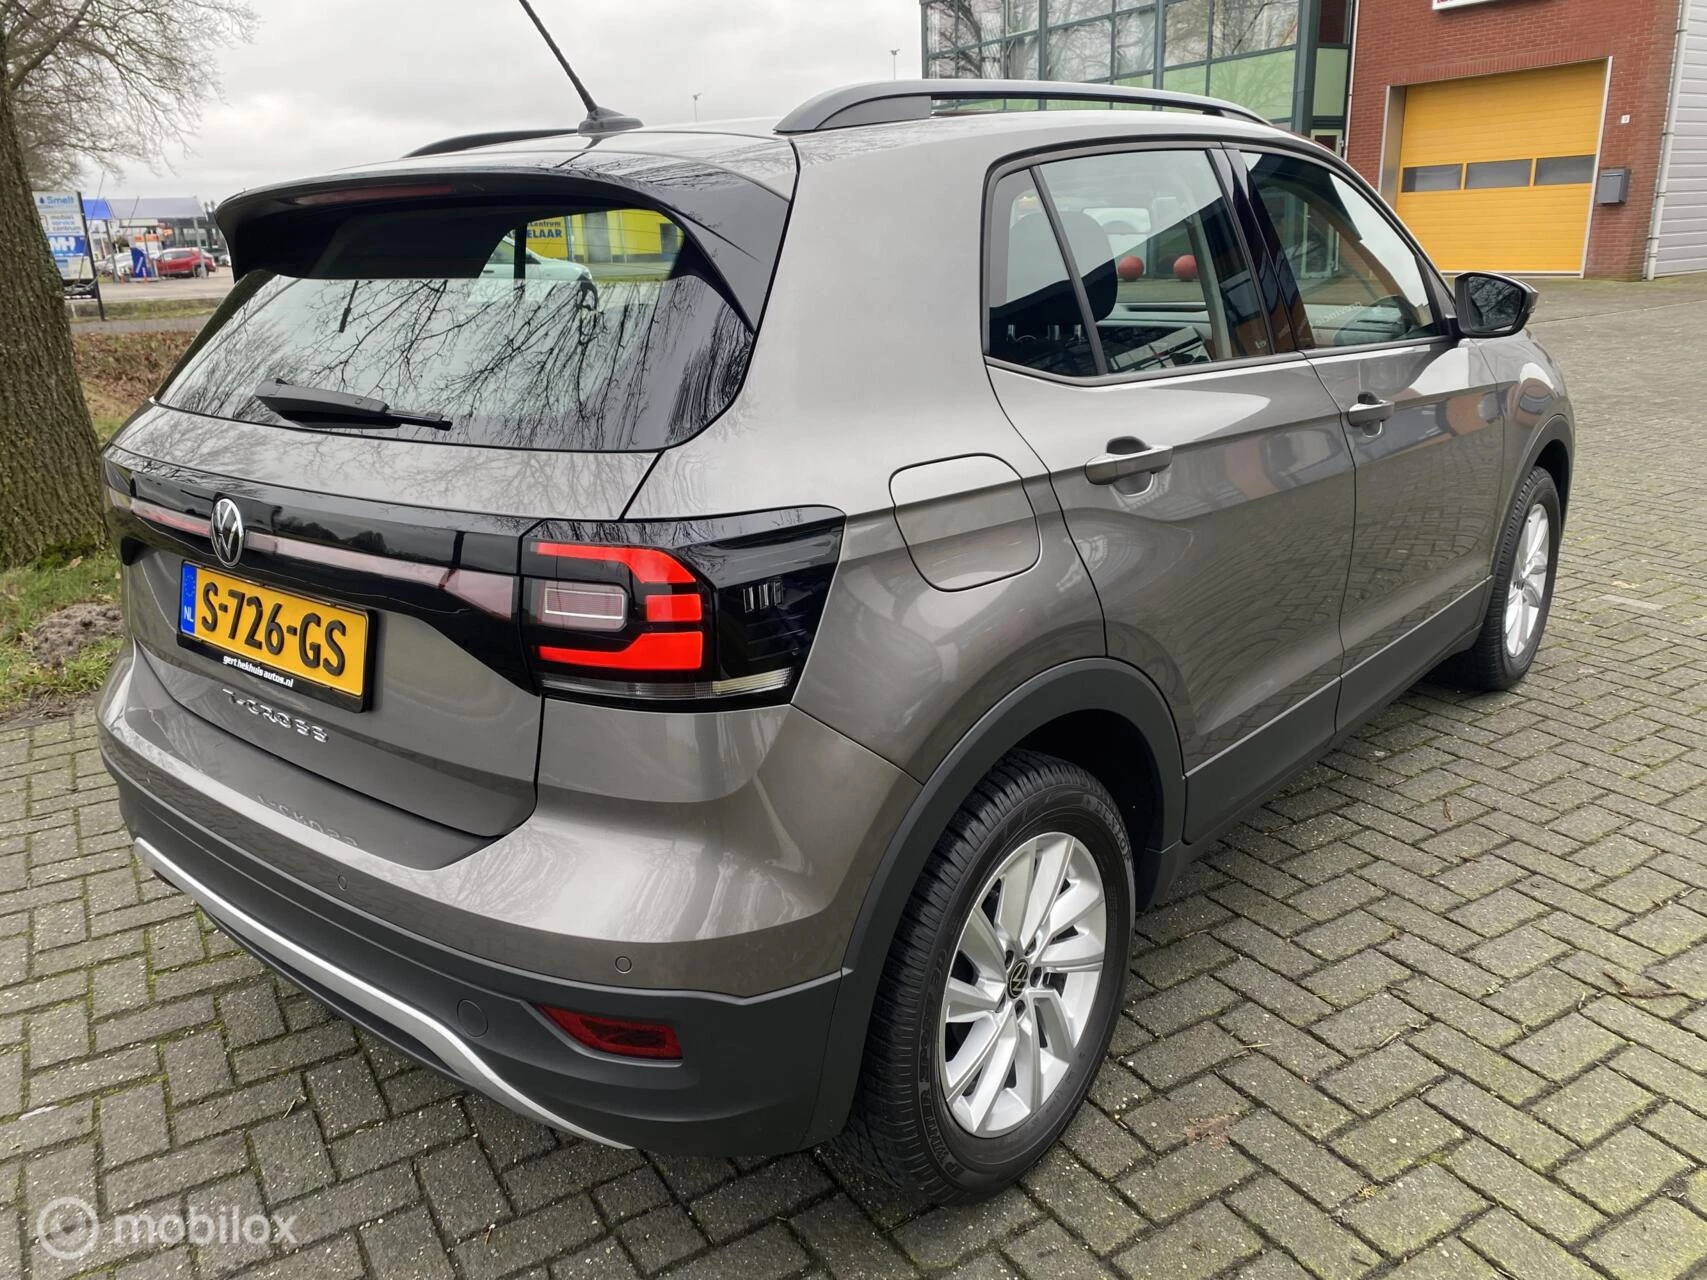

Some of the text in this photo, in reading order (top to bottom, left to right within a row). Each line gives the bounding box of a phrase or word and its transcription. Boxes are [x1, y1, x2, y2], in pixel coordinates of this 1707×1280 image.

[183, 605, 194, 623] NL
[201, 581, 347, 677] S-726-GS
[222, 655, 294, 688] gert hekhuis autos.nl
